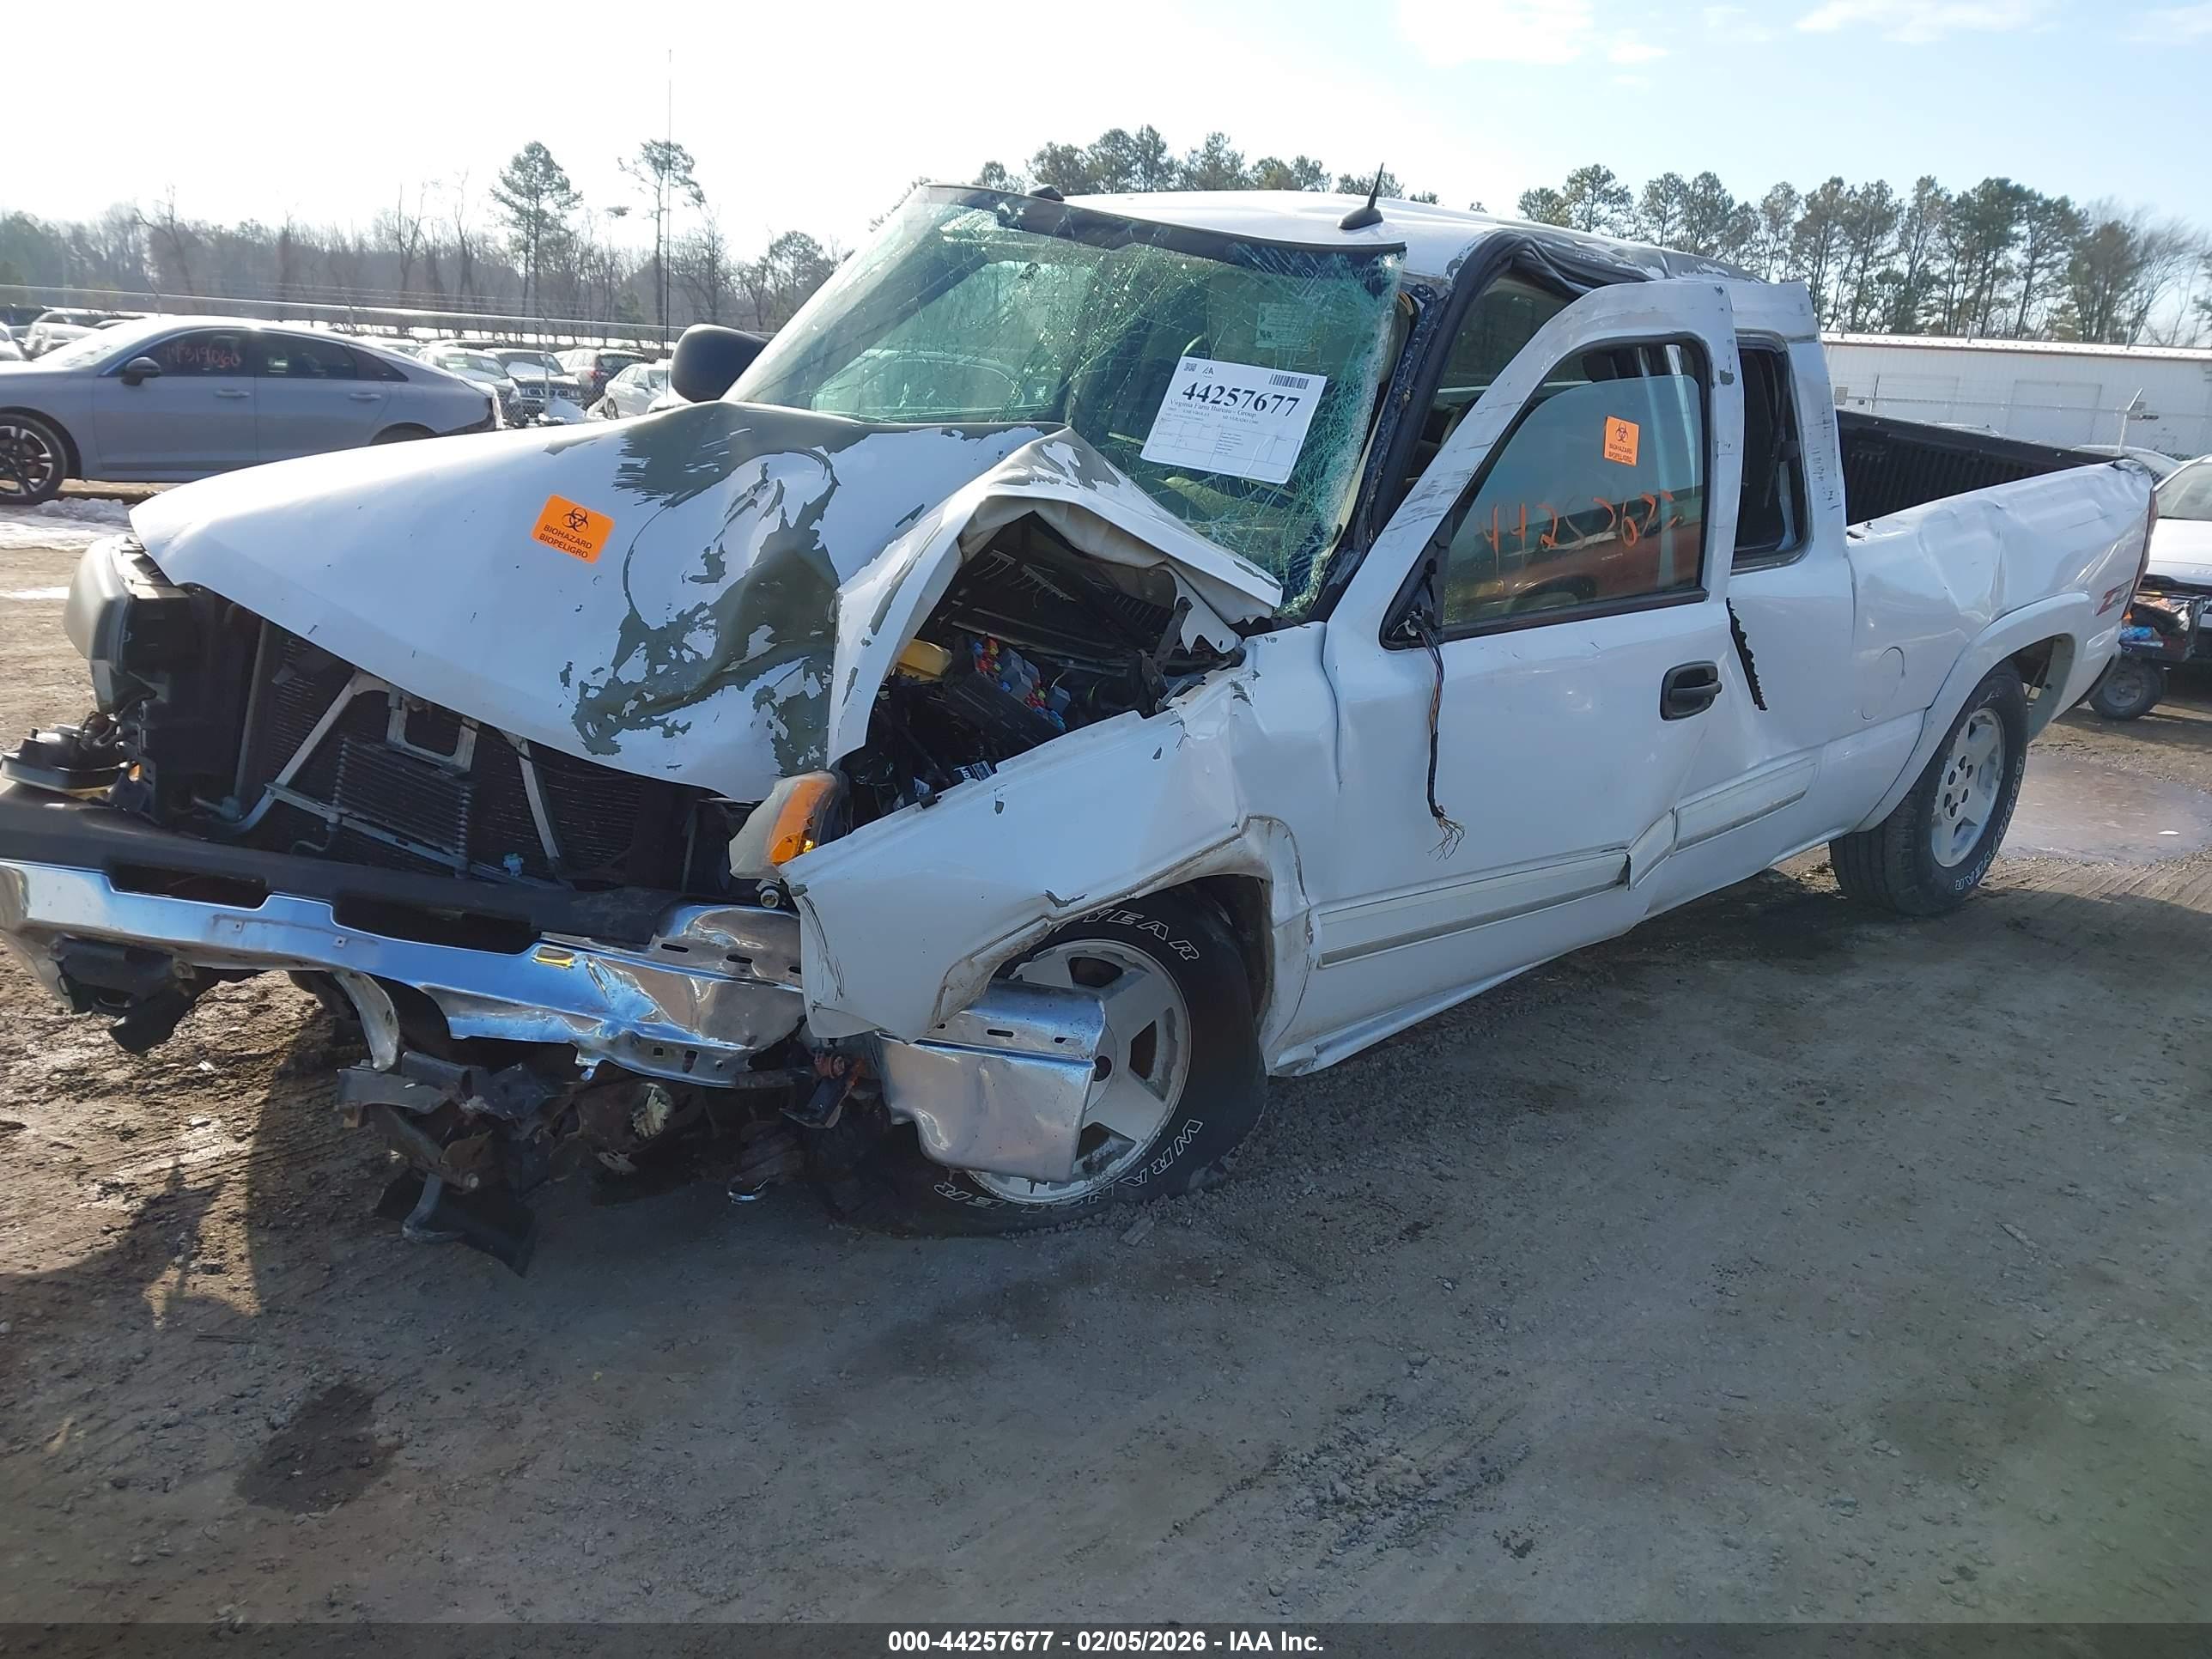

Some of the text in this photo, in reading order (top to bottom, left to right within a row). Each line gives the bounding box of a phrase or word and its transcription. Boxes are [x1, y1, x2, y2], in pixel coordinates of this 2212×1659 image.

[1170, 398, 1193, 409] Virginia
[1194, 402, 1210, 411] Farm
[1211, 404, 1232, 414] Bureau
[1237, 410, 1257, 418] Group
[1182, 381, 1300, 417] 44257677
[1608, 443, 1633, 454] BIOHAZARD
[538, 532, 589, 558] BIOPELIGRO
[543, 524, 592, 549] BIOHAZARD
[1054, 908, 1200, 962] YEAR
